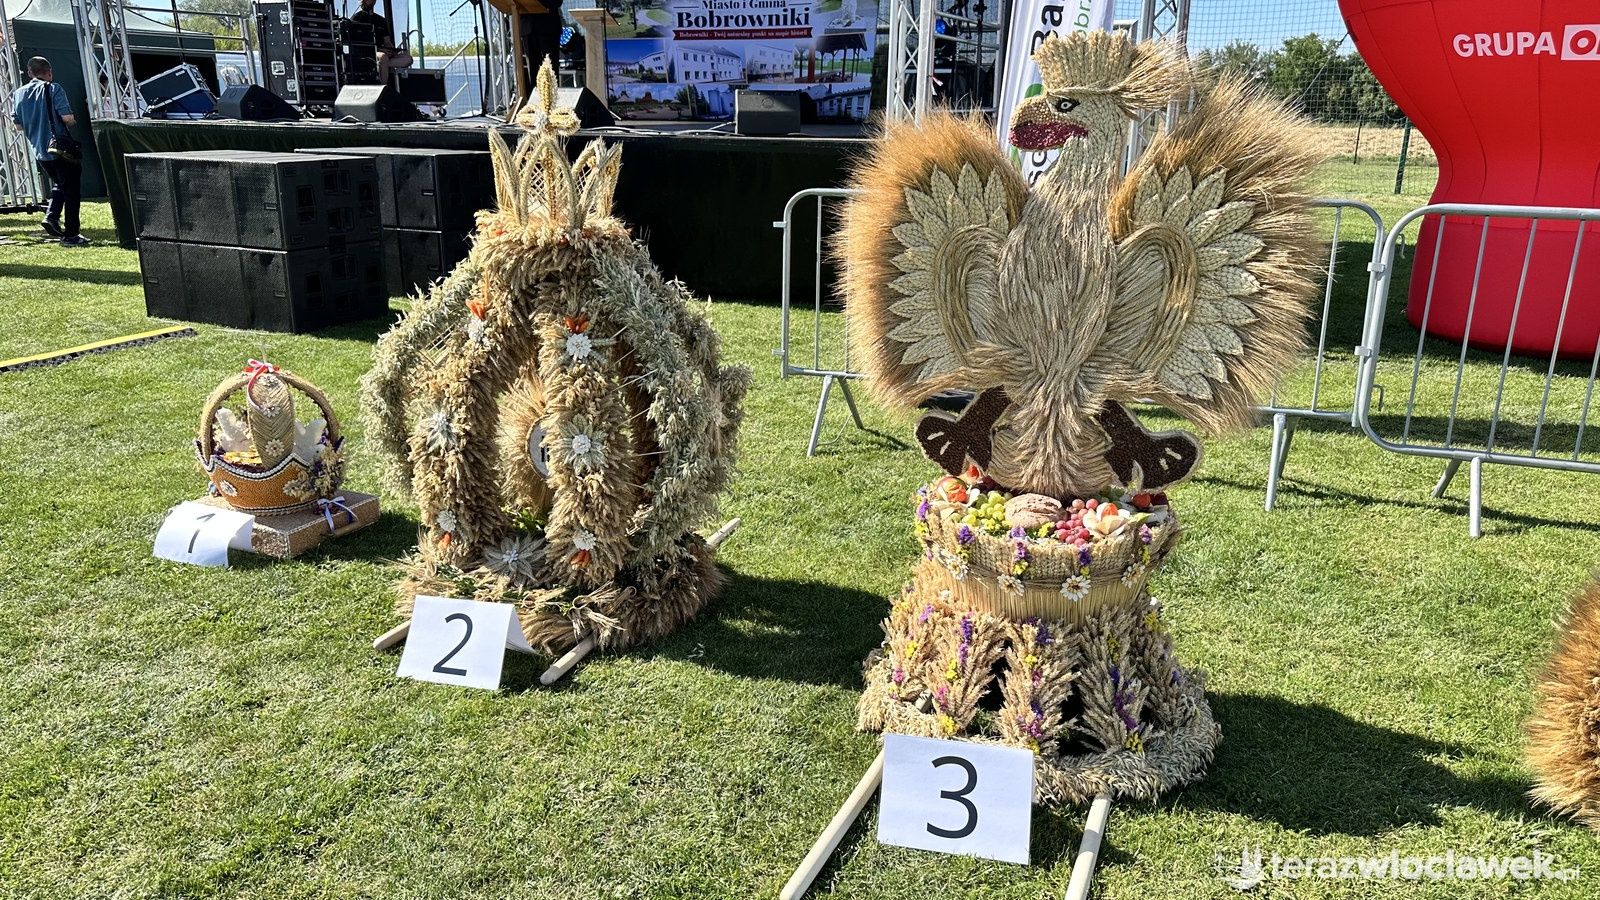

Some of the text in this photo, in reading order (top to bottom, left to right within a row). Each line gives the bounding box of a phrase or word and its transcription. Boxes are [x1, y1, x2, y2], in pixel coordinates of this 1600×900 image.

[677, 7, 810, 28] Bobrowniki
[702, 0, 786, 10] Miasto i Gmina
[1453, 29, 1600, 57] GRUPA O
[188, 513, 216, 553] 1
[432, 613, 473, 677] 2
[926, 755, 978, 839] 3
